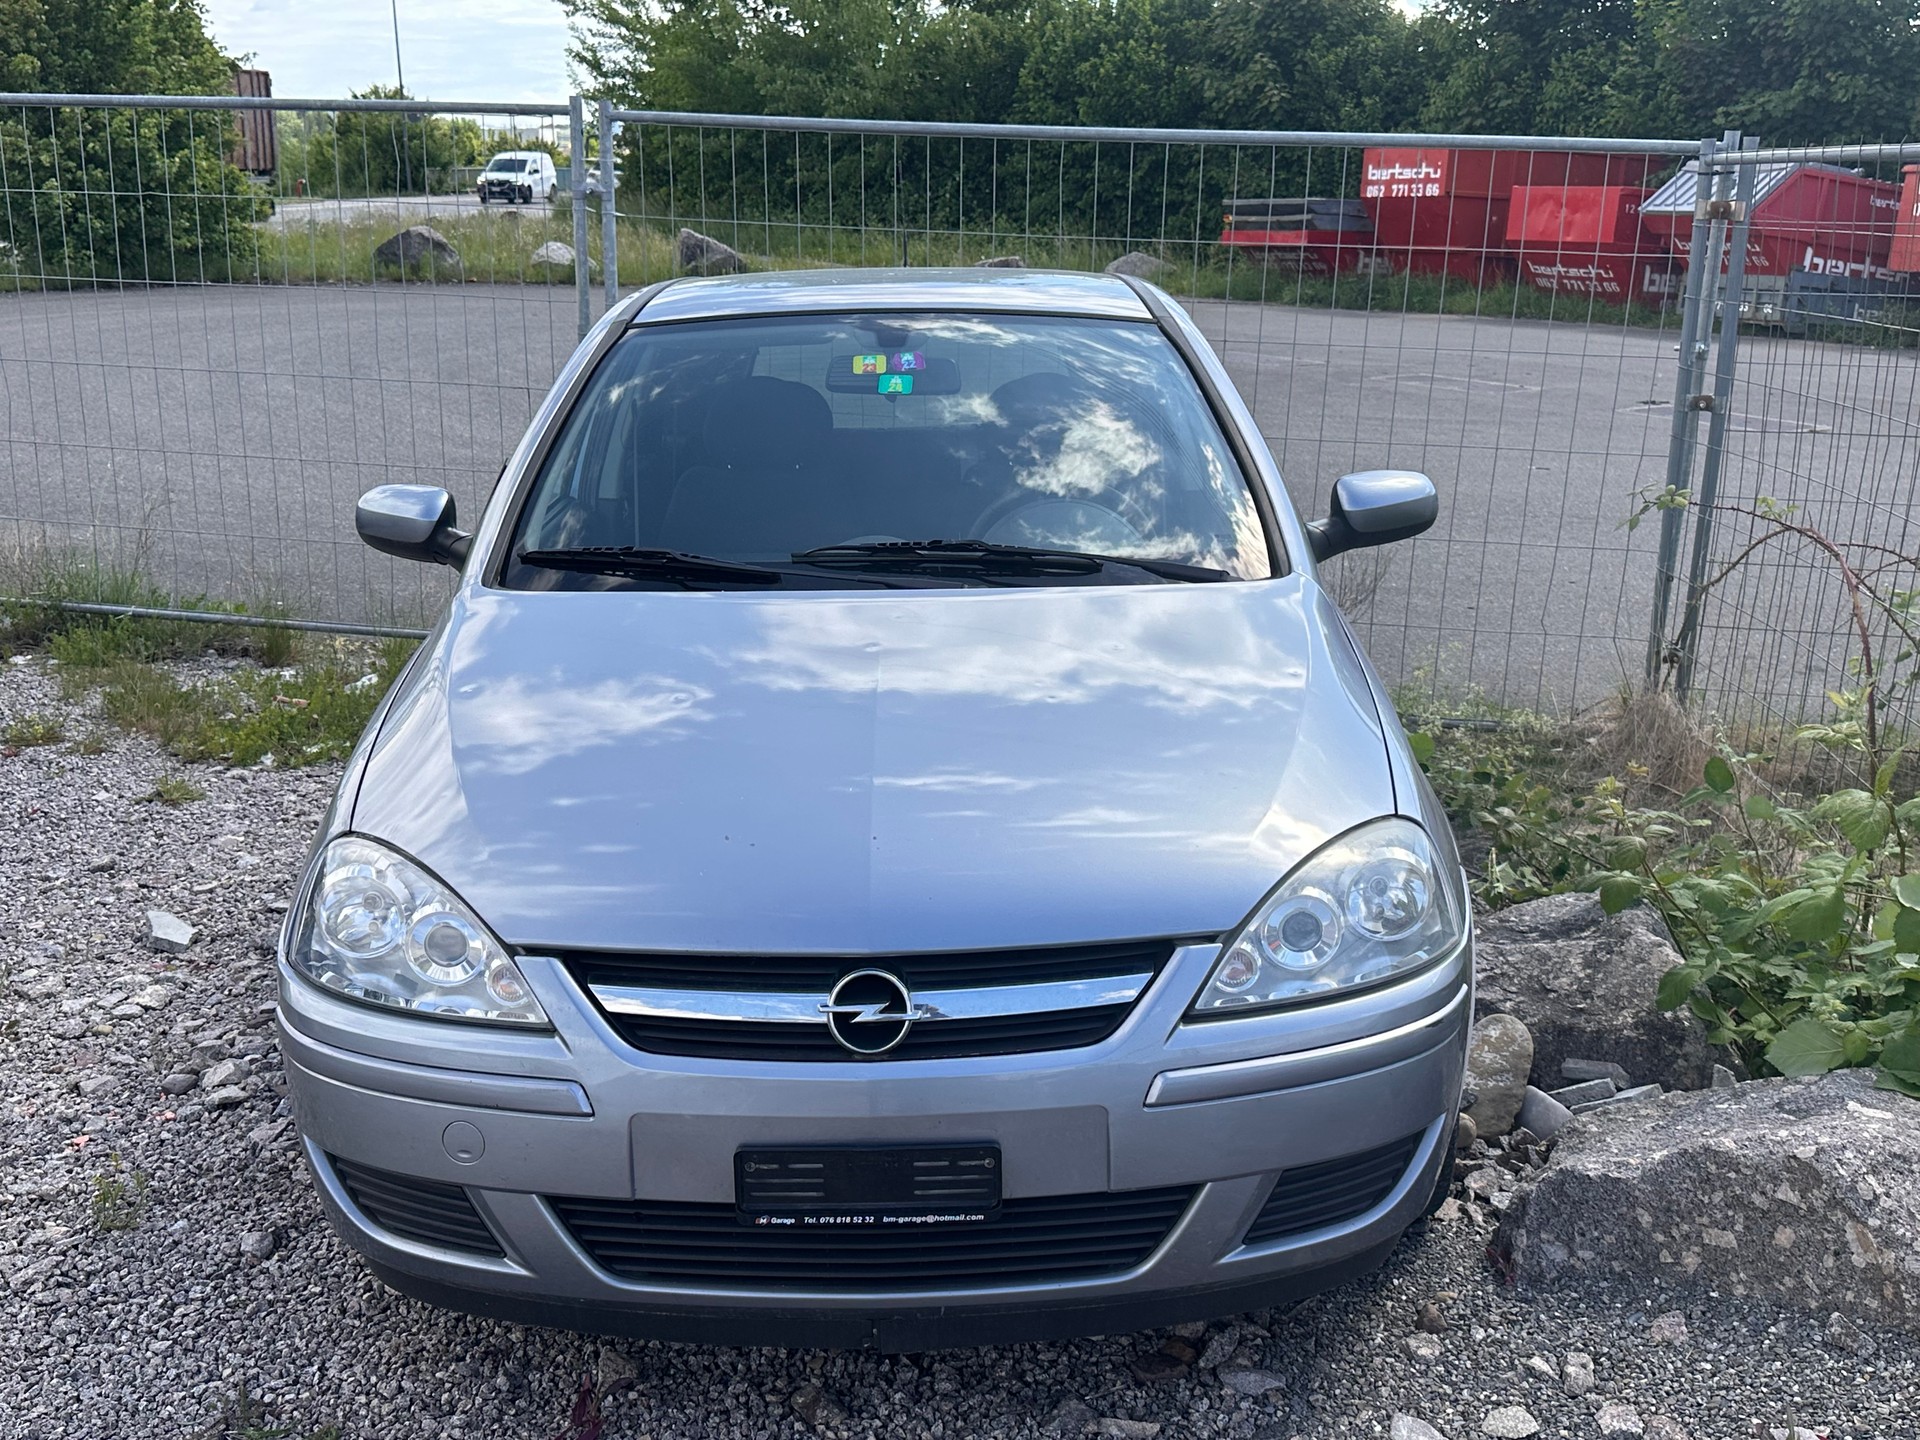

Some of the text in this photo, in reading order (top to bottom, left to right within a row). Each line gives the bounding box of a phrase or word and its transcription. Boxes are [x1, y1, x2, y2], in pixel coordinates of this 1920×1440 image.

[1368, 161, 1442, 180] bertschi
[1366, 184, 1440, 198] 062 771 33 66
[1527, 260, 1614, 278] bertschi
[1563, 280, 1585, 291] 771
[771, 1216, 795, 1225] Garage
[804, 1216, 818, 1224] Tel.
[819, 1216, 835, 1224] 076
[883, 1214, 984, 1224] bm-garage@hotmail.com
